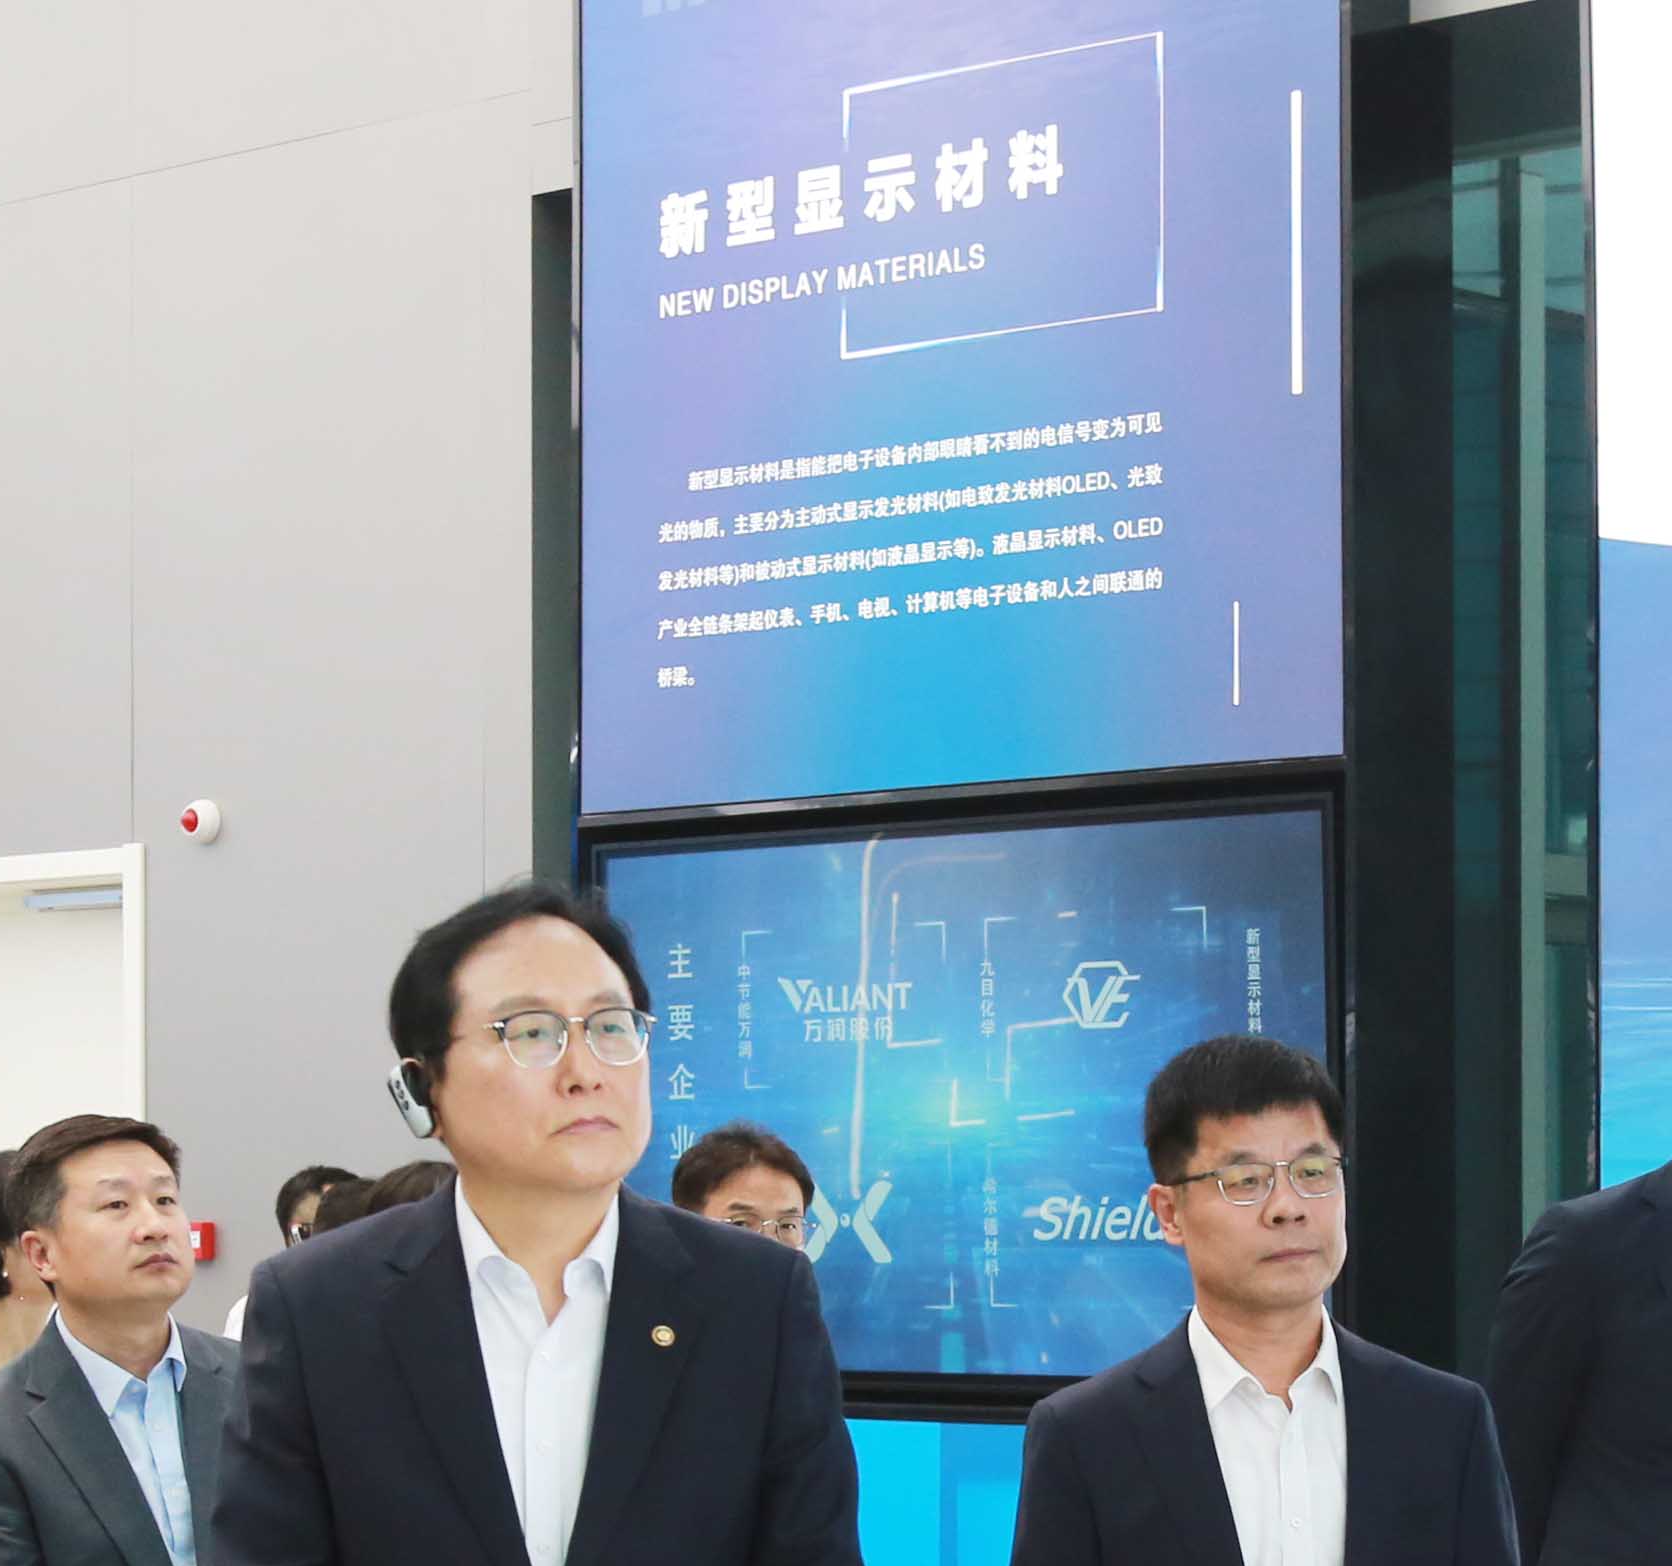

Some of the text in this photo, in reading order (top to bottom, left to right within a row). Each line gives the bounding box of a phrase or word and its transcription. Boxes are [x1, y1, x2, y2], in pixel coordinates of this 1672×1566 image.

[659, 124, 1064, 258] 新型显示材料
[659, 242, 986, 318] NEW DISPLAY MATERIALS
[688, 412, 1162, 492] 新型显示材料是指能把电子设备内部眼睛看不到的电信号变为可见
[657, 666, 696, 689] 桥梁。
[777, 976, 913, 1013] VALIANT
[979, 960, 996, 1038] 九目化学
[1245, 927, 1263, 1034] 新型显示材料
[667, 944, 696, 1160] 主要企业
[802, 1016, 894, 1044] 万润股份
